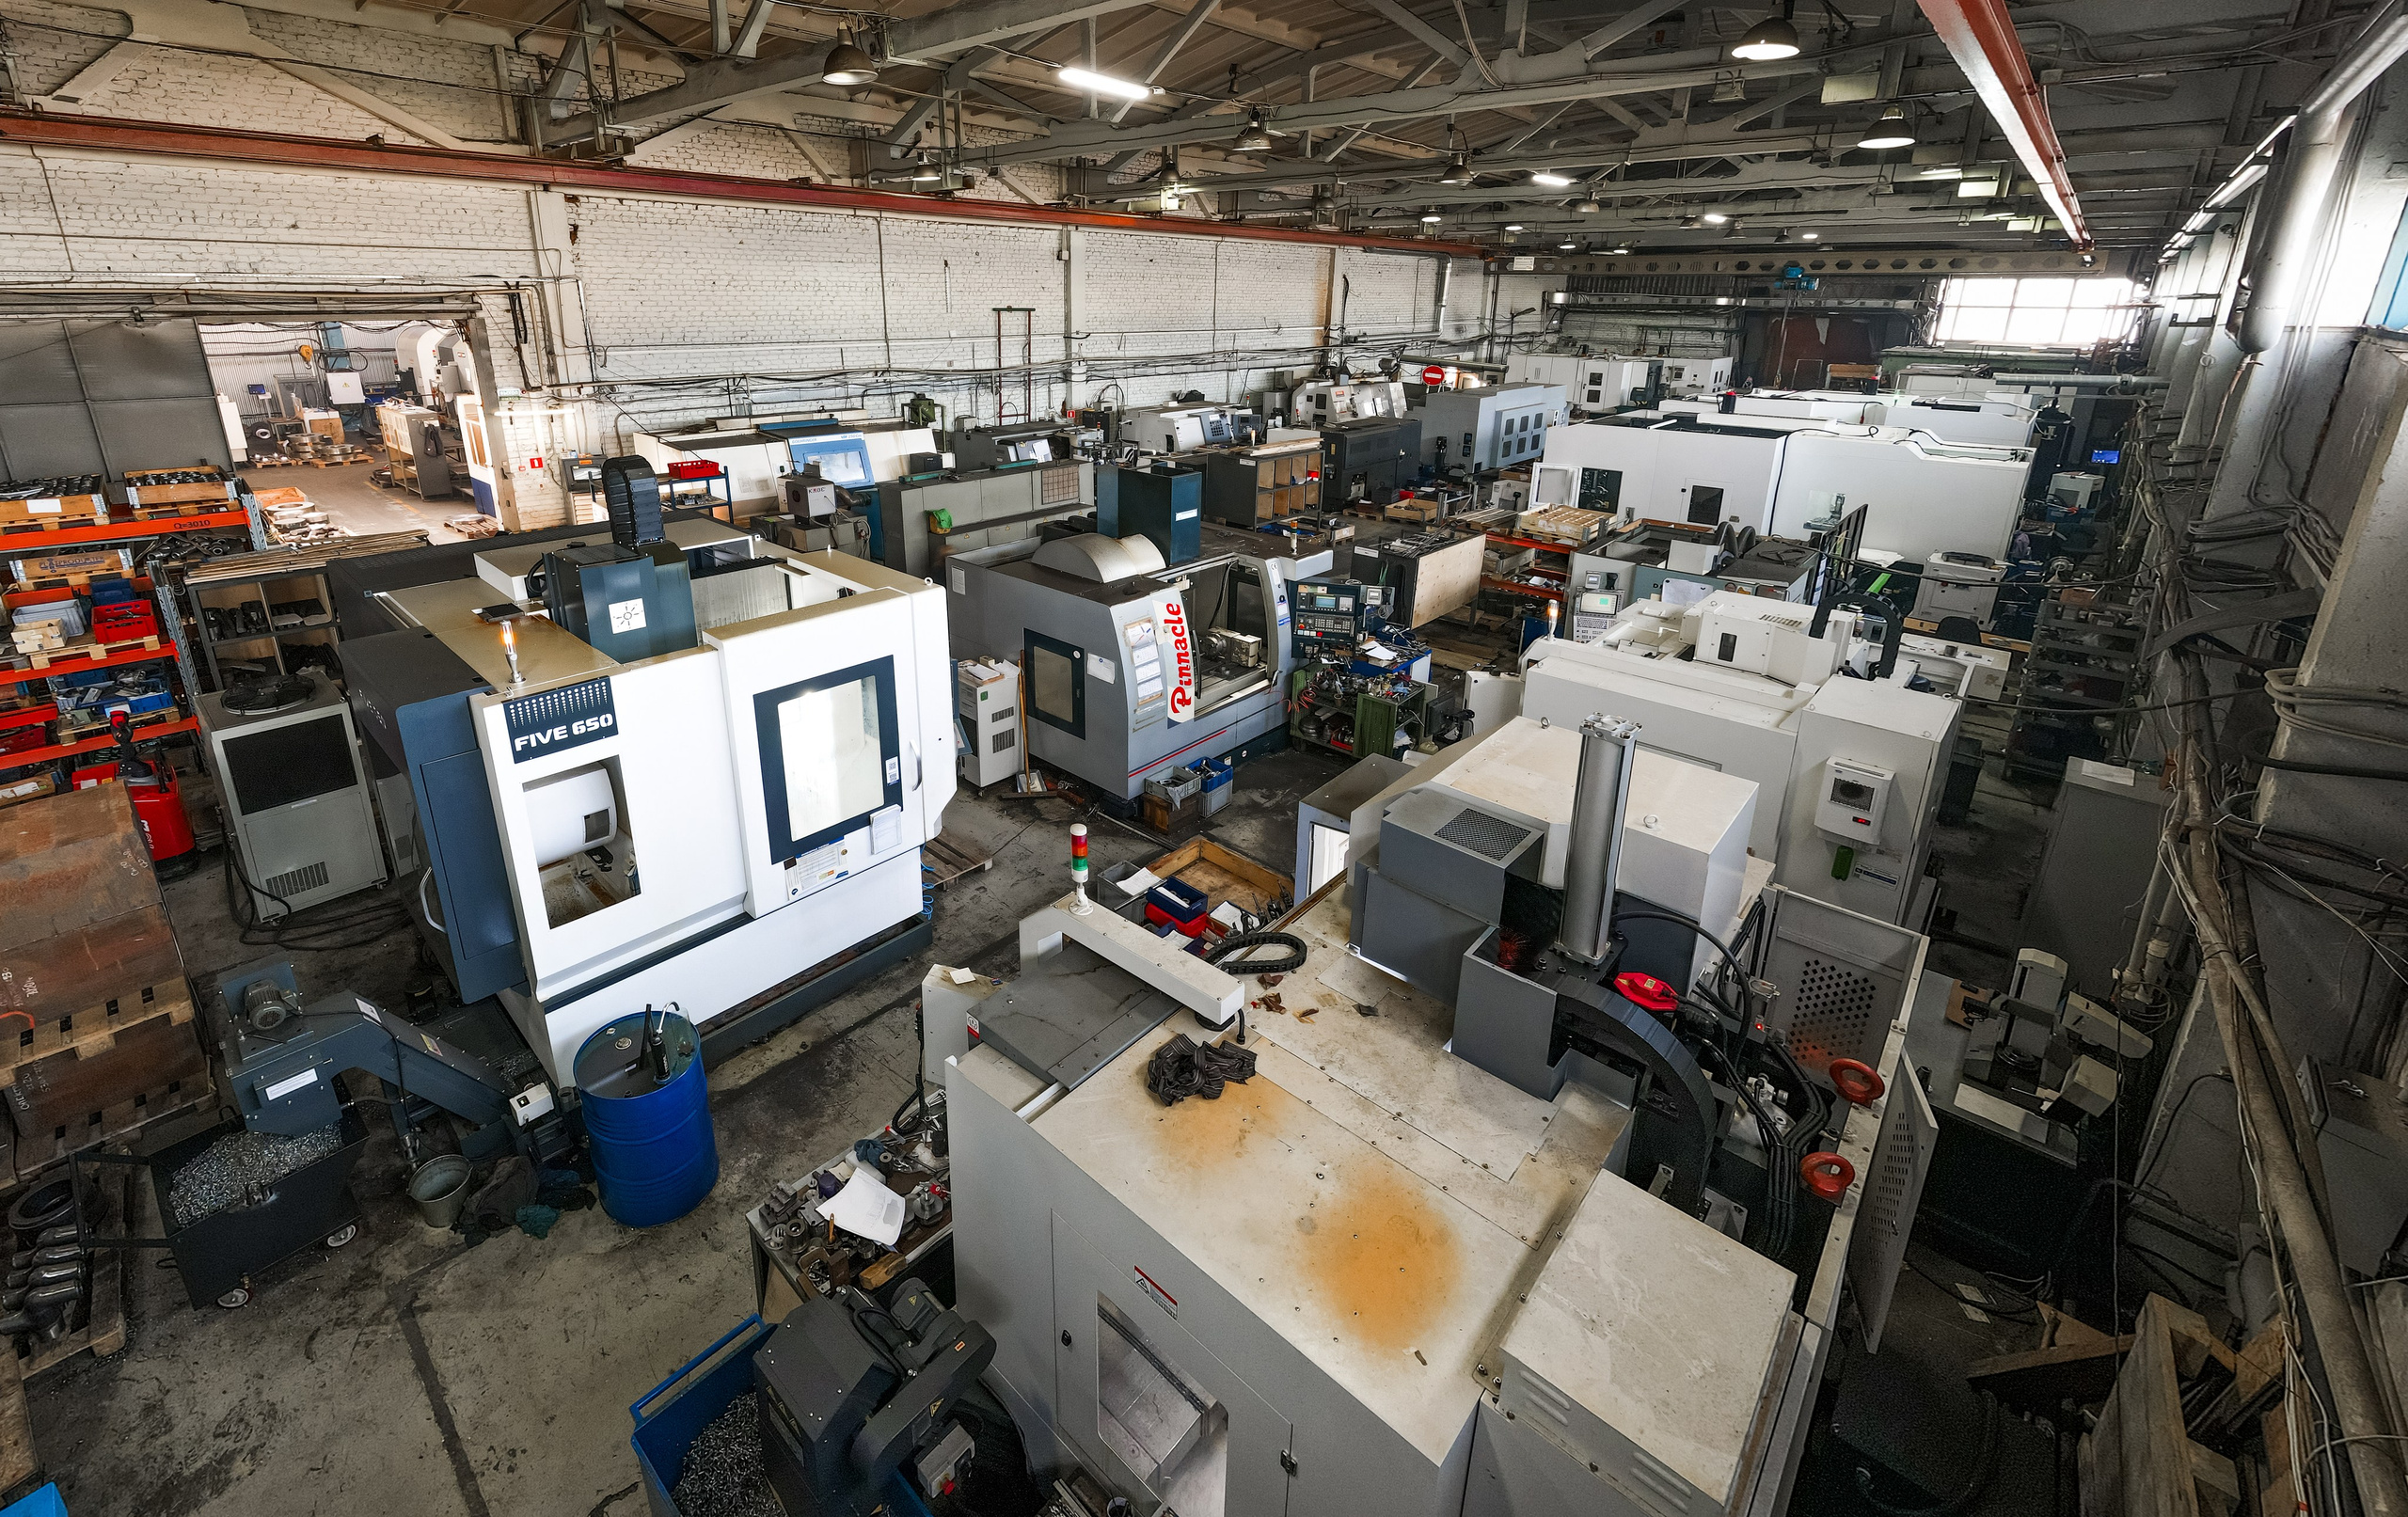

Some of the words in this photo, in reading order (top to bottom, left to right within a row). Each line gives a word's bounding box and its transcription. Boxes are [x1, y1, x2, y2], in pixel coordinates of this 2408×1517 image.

[174, 519, 210, 529] Q=3010
[1164, 603, 1192, 714] Pinnacle
[514, 725, 568, 752] FIVE
[572, 713, 613, 735] 650
